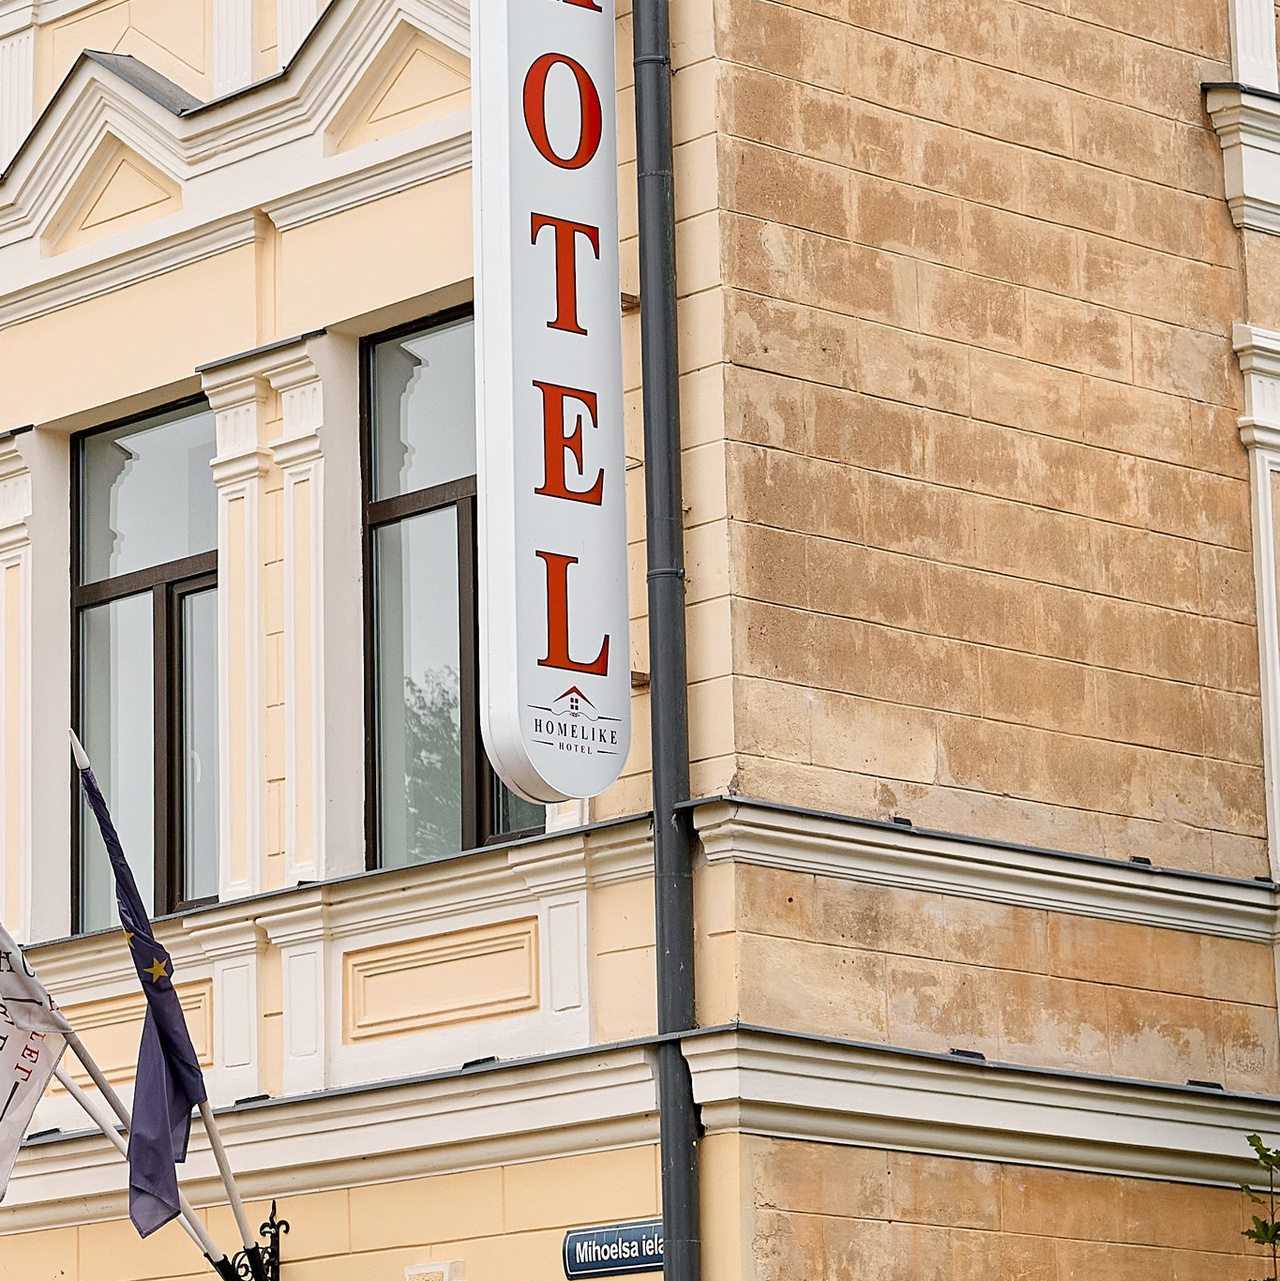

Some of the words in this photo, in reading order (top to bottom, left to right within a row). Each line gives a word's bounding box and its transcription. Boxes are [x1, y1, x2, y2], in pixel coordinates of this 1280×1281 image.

[534, 718, 617, 745] HOMELIKE
[559, 742, 592, 755] HOTEL
[575, 1237, 639, 1264] Mihoelsa
